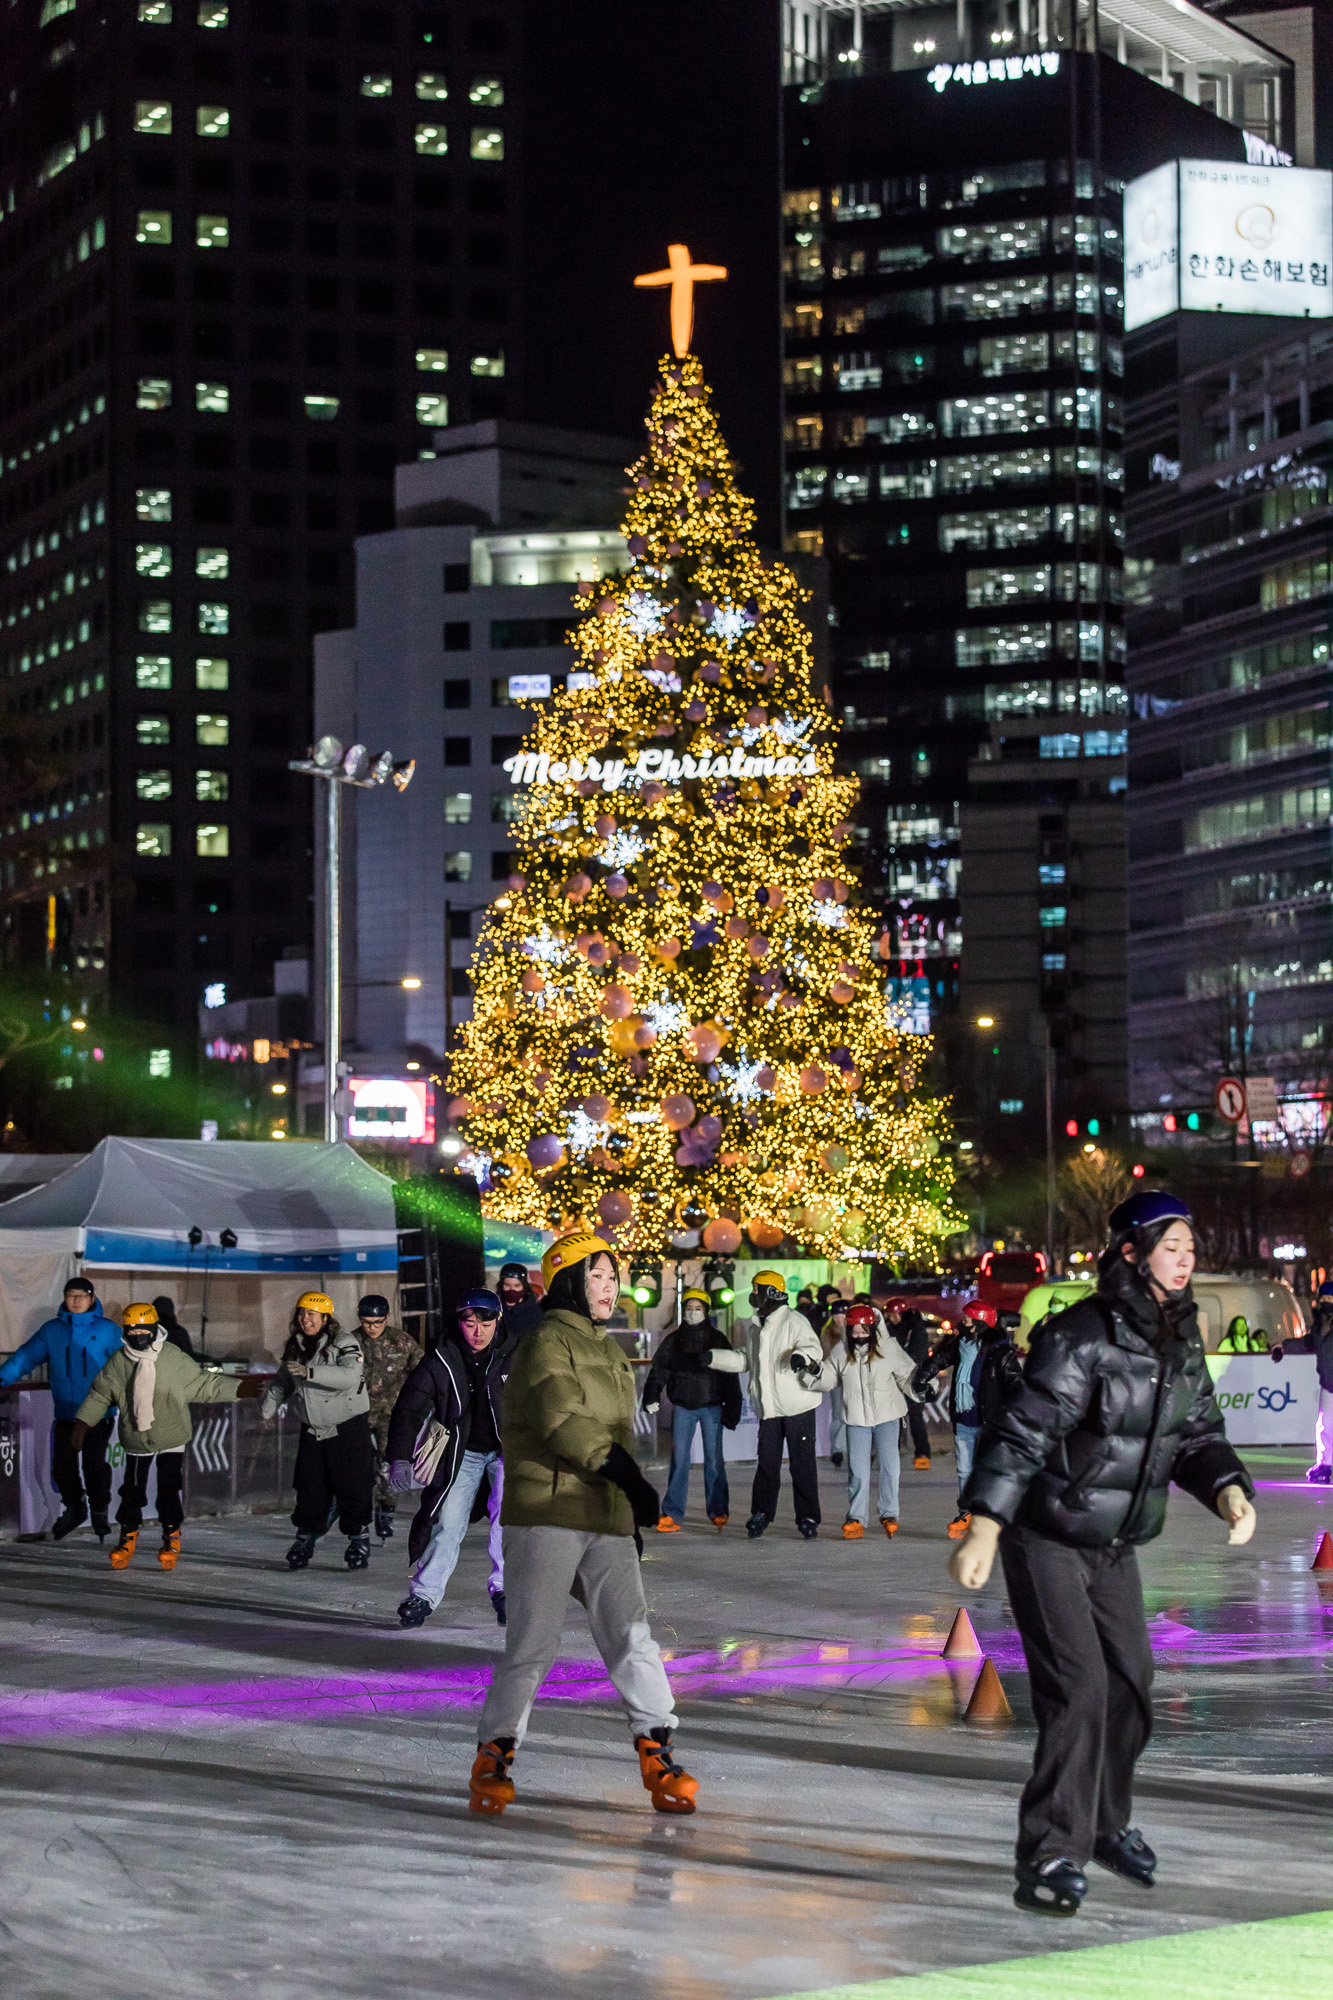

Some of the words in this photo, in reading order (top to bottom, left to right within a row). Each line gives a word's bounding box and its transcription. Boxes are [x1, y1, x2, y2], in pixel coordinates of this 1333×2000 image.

[952, 51, 1060, 86] 서울특별시청
[1188, 253, 1328, 287] 한화손해보험
[502, 751, 626, 792] Merry
[634, 747, 823, 781] Christmas
[1213, 1391, 1255, 1410] per
